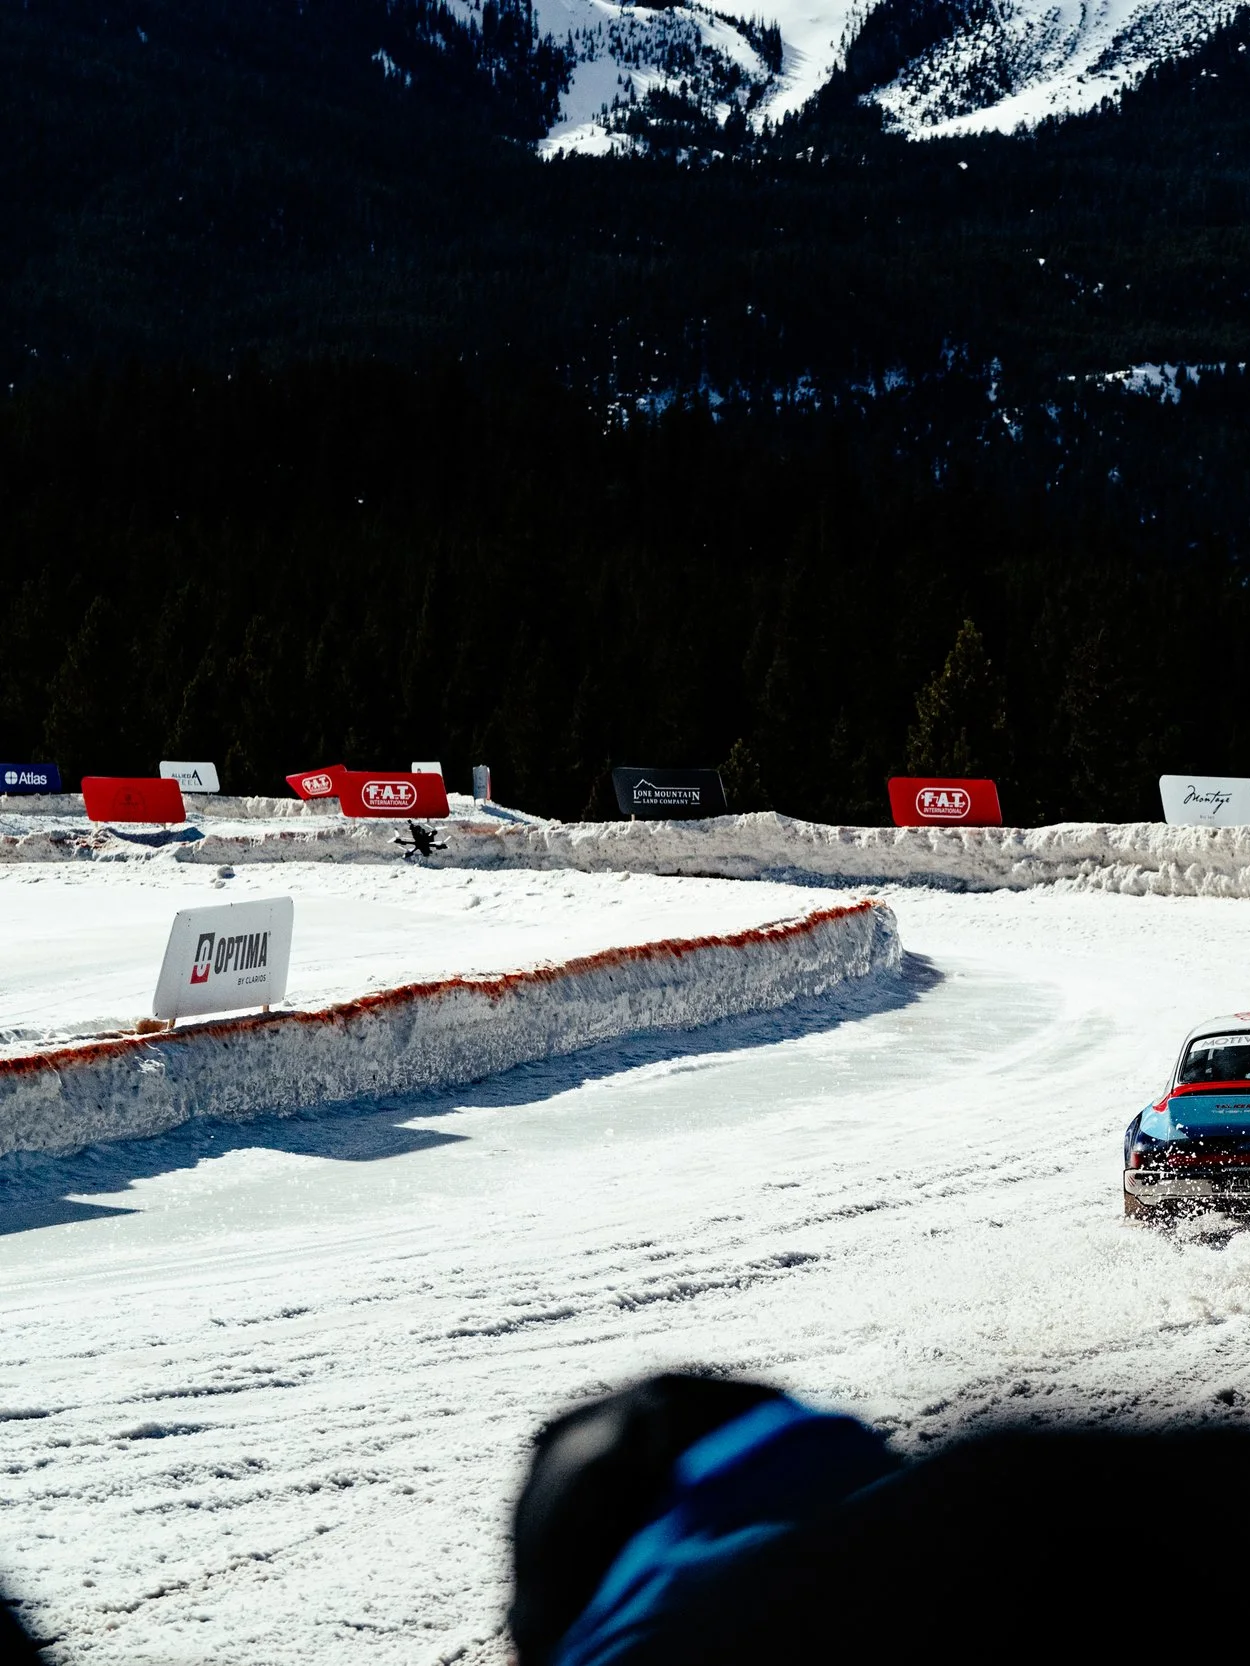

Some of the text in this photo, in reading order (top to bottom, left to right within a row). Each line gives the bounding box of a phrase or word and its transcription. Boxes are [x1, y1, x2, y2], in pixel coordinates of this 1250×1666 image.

[19, 772, 47, 785] Atlas
[367, 785, 411, 800] F.A.T.
[633, 790, 700, 801] LONE MOUNTAIN
[1183, 785, 1232, 815] Montage
[214, 931, 268, 975] OPTIMA
[237, 974, 267, 986] BY CLARIOS
